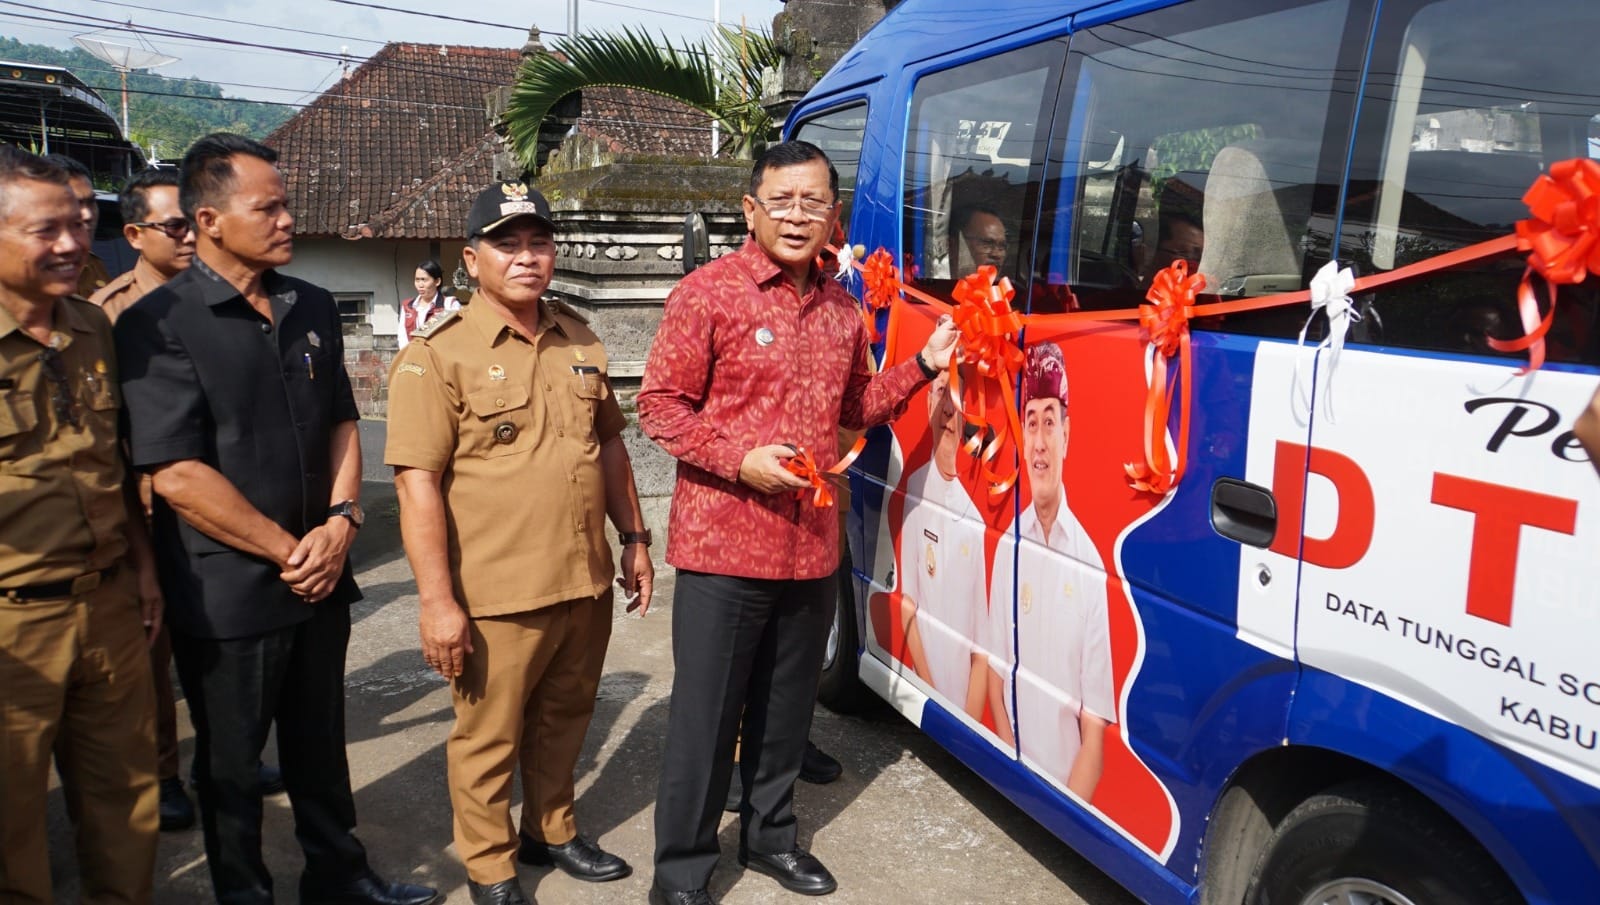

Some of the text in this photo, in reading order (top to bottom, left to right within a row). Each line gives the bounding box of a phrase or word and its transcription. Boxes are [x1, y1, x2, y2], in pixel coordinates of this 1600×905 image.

[1326, 593, 1390, 631] DATA
[1398, 616, 1546, 687] TUNGGAL
[1501, 696, 1596, 750] KABU
